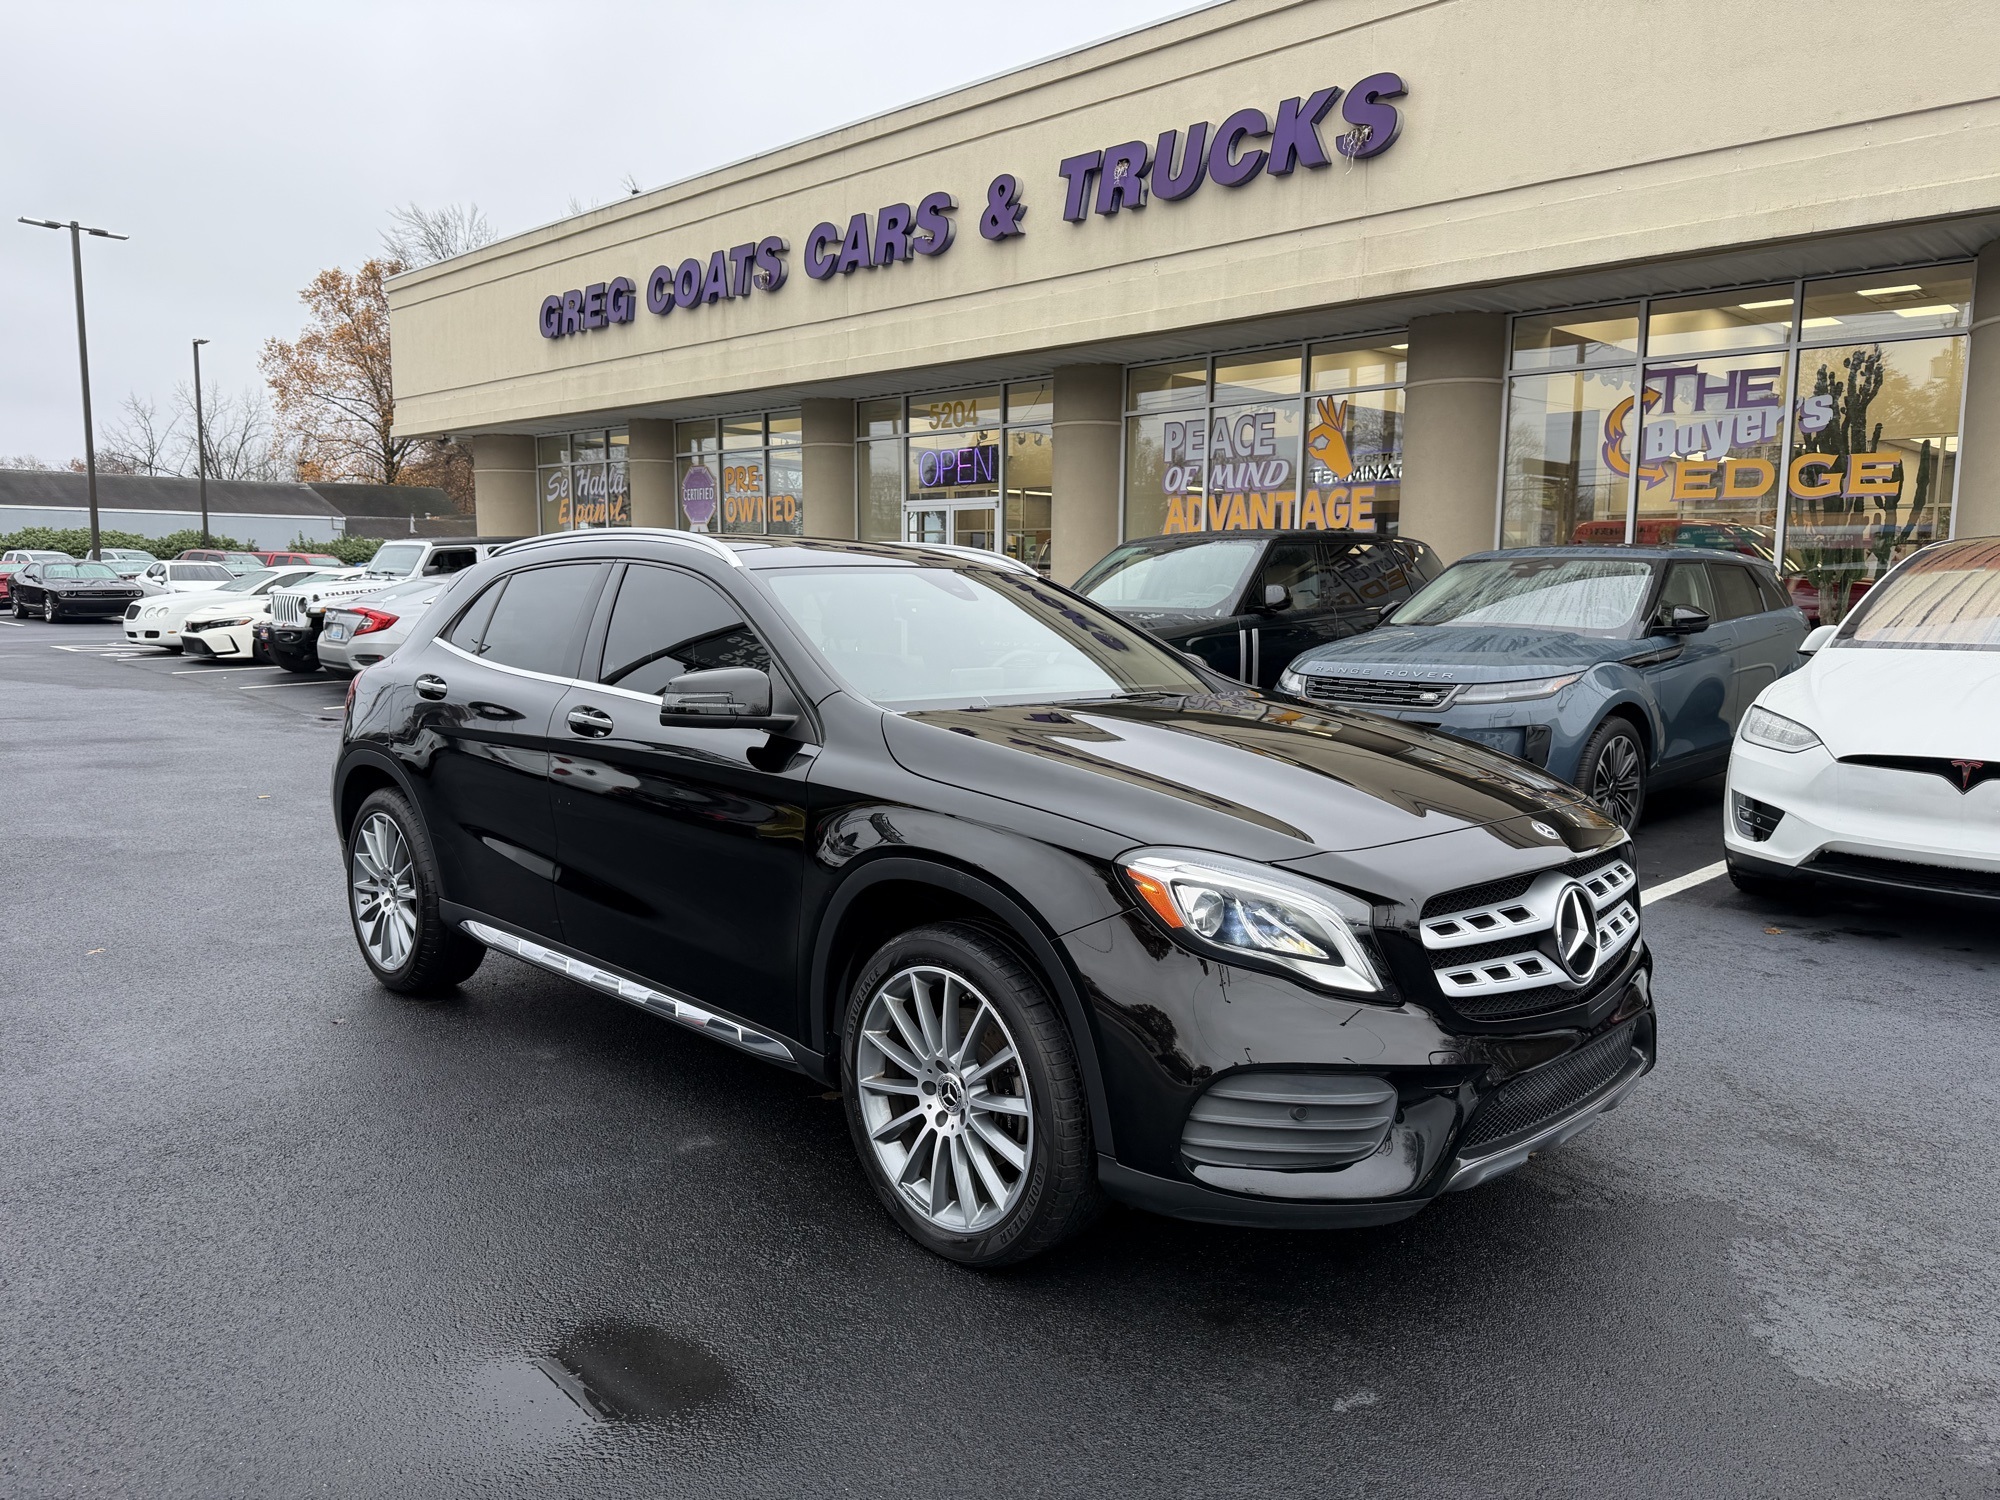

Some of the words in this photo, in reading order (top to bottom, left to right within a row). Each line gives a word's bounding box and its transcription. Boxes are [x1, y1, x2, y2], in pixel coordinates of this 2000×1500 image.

[540, 276, 636, 339] GREG
[646, 236, 790, 316] COATS
[804, 191, 959, 281] CARS
[980, 173, 1028, 241] &
[1059, 72, 1408, 224] TRUCKS
[1645, 364, 1781, 413] THE
[929, 400, 978, 430] 5204
[1163, 411, 1276, 463] PEACE
[919, 446, 993, 487] OPEN
[1164, 463, 1199, 494] OF
[1207, 458, 1290, 492] MIND
[1671, 452, 1902, 501] EDGE
[546, 471, 569, 502] Se
[683, 487, 714, 501] CERTIFIED
[724, 495, 796, 522] OWNED
[1162, 486, 1376, 536] ADVANTAGE
[325, 587, 383, 597] RUBICO
[1315, 665, 1371, 676] RANGE
[1384, 669, 1454, 679] ROVER
